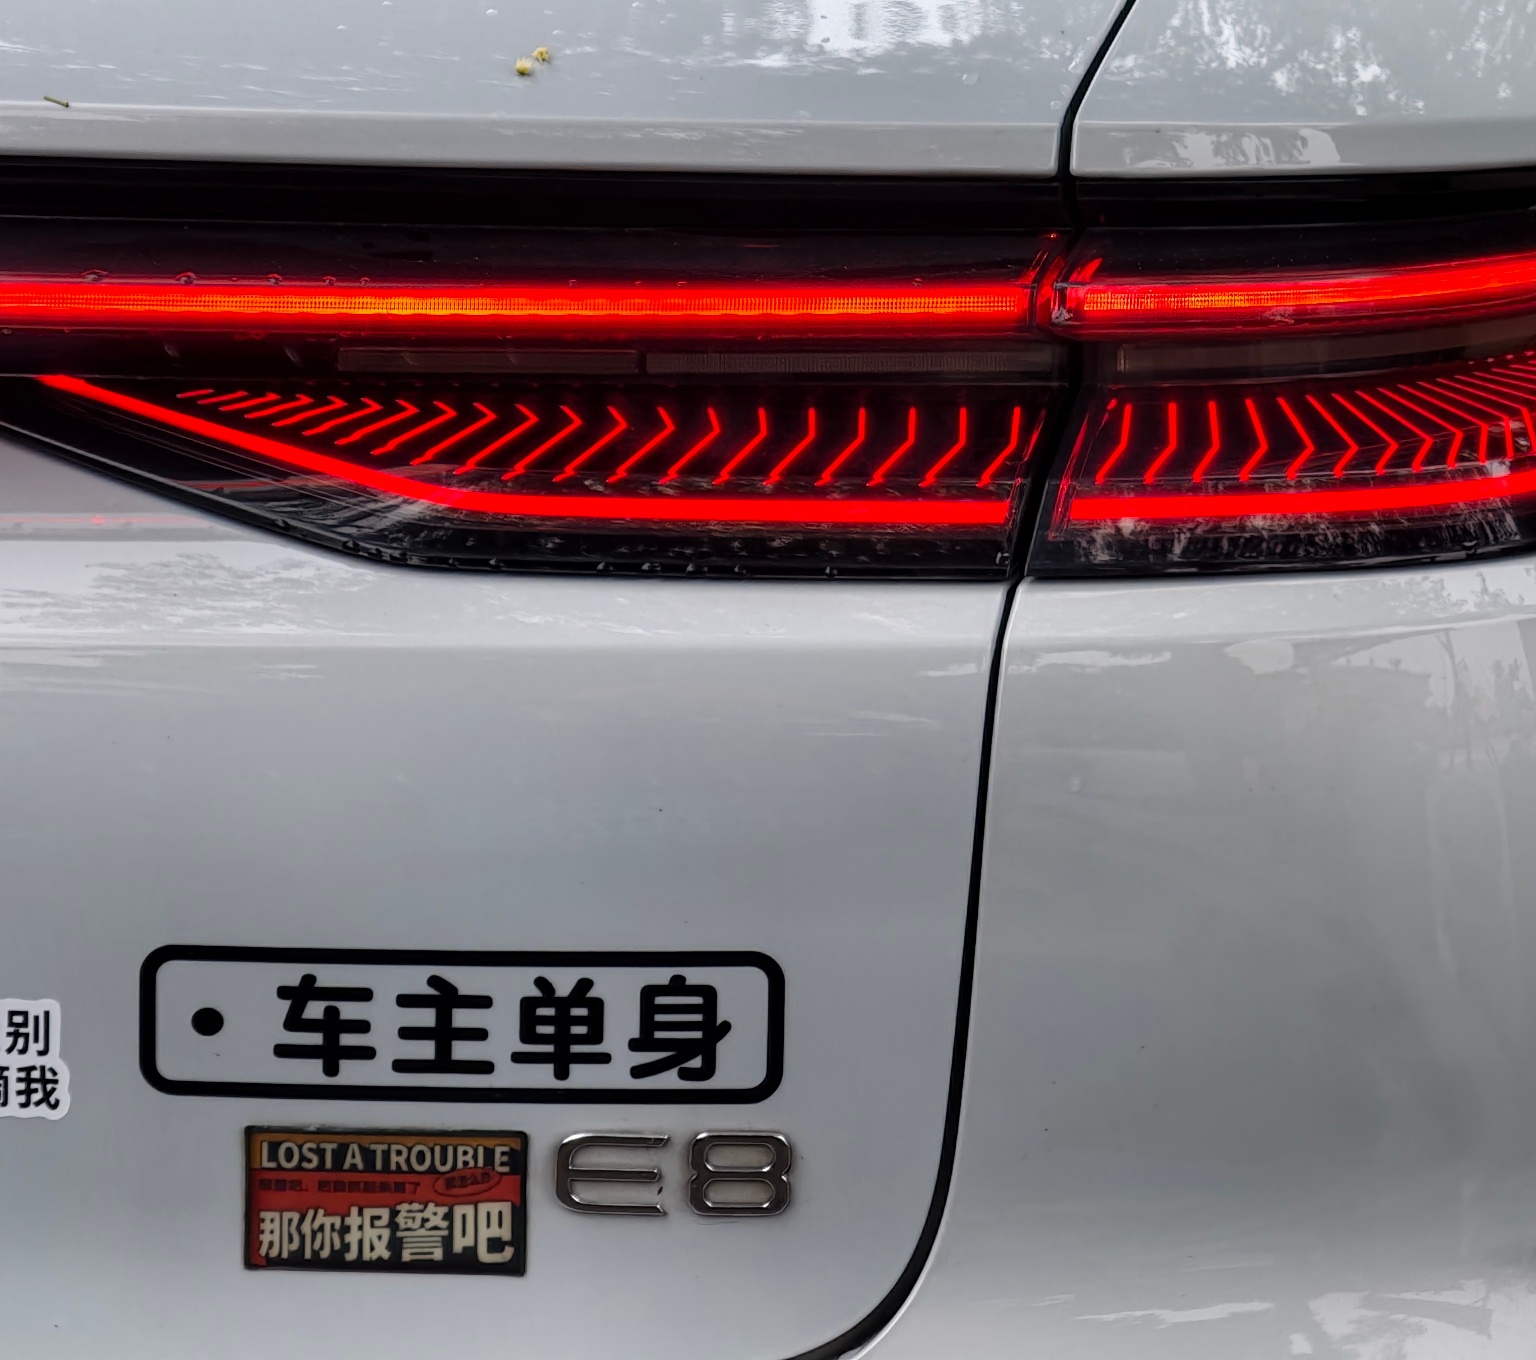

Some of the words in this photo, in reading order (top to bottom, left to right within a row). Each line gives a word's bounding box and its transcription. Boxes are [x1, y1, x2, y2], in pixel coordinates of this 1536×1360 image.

[5, 1010, 50, 1056] 别
[273, 974, 732, 1081] 车主单身
[261, 1141, 338, 1169] LOST
[343, 1143, 363, 1170] A
[555, 1131, 793, 1217] E8
[259, 1201, 515, 1263] 那你报警吧
